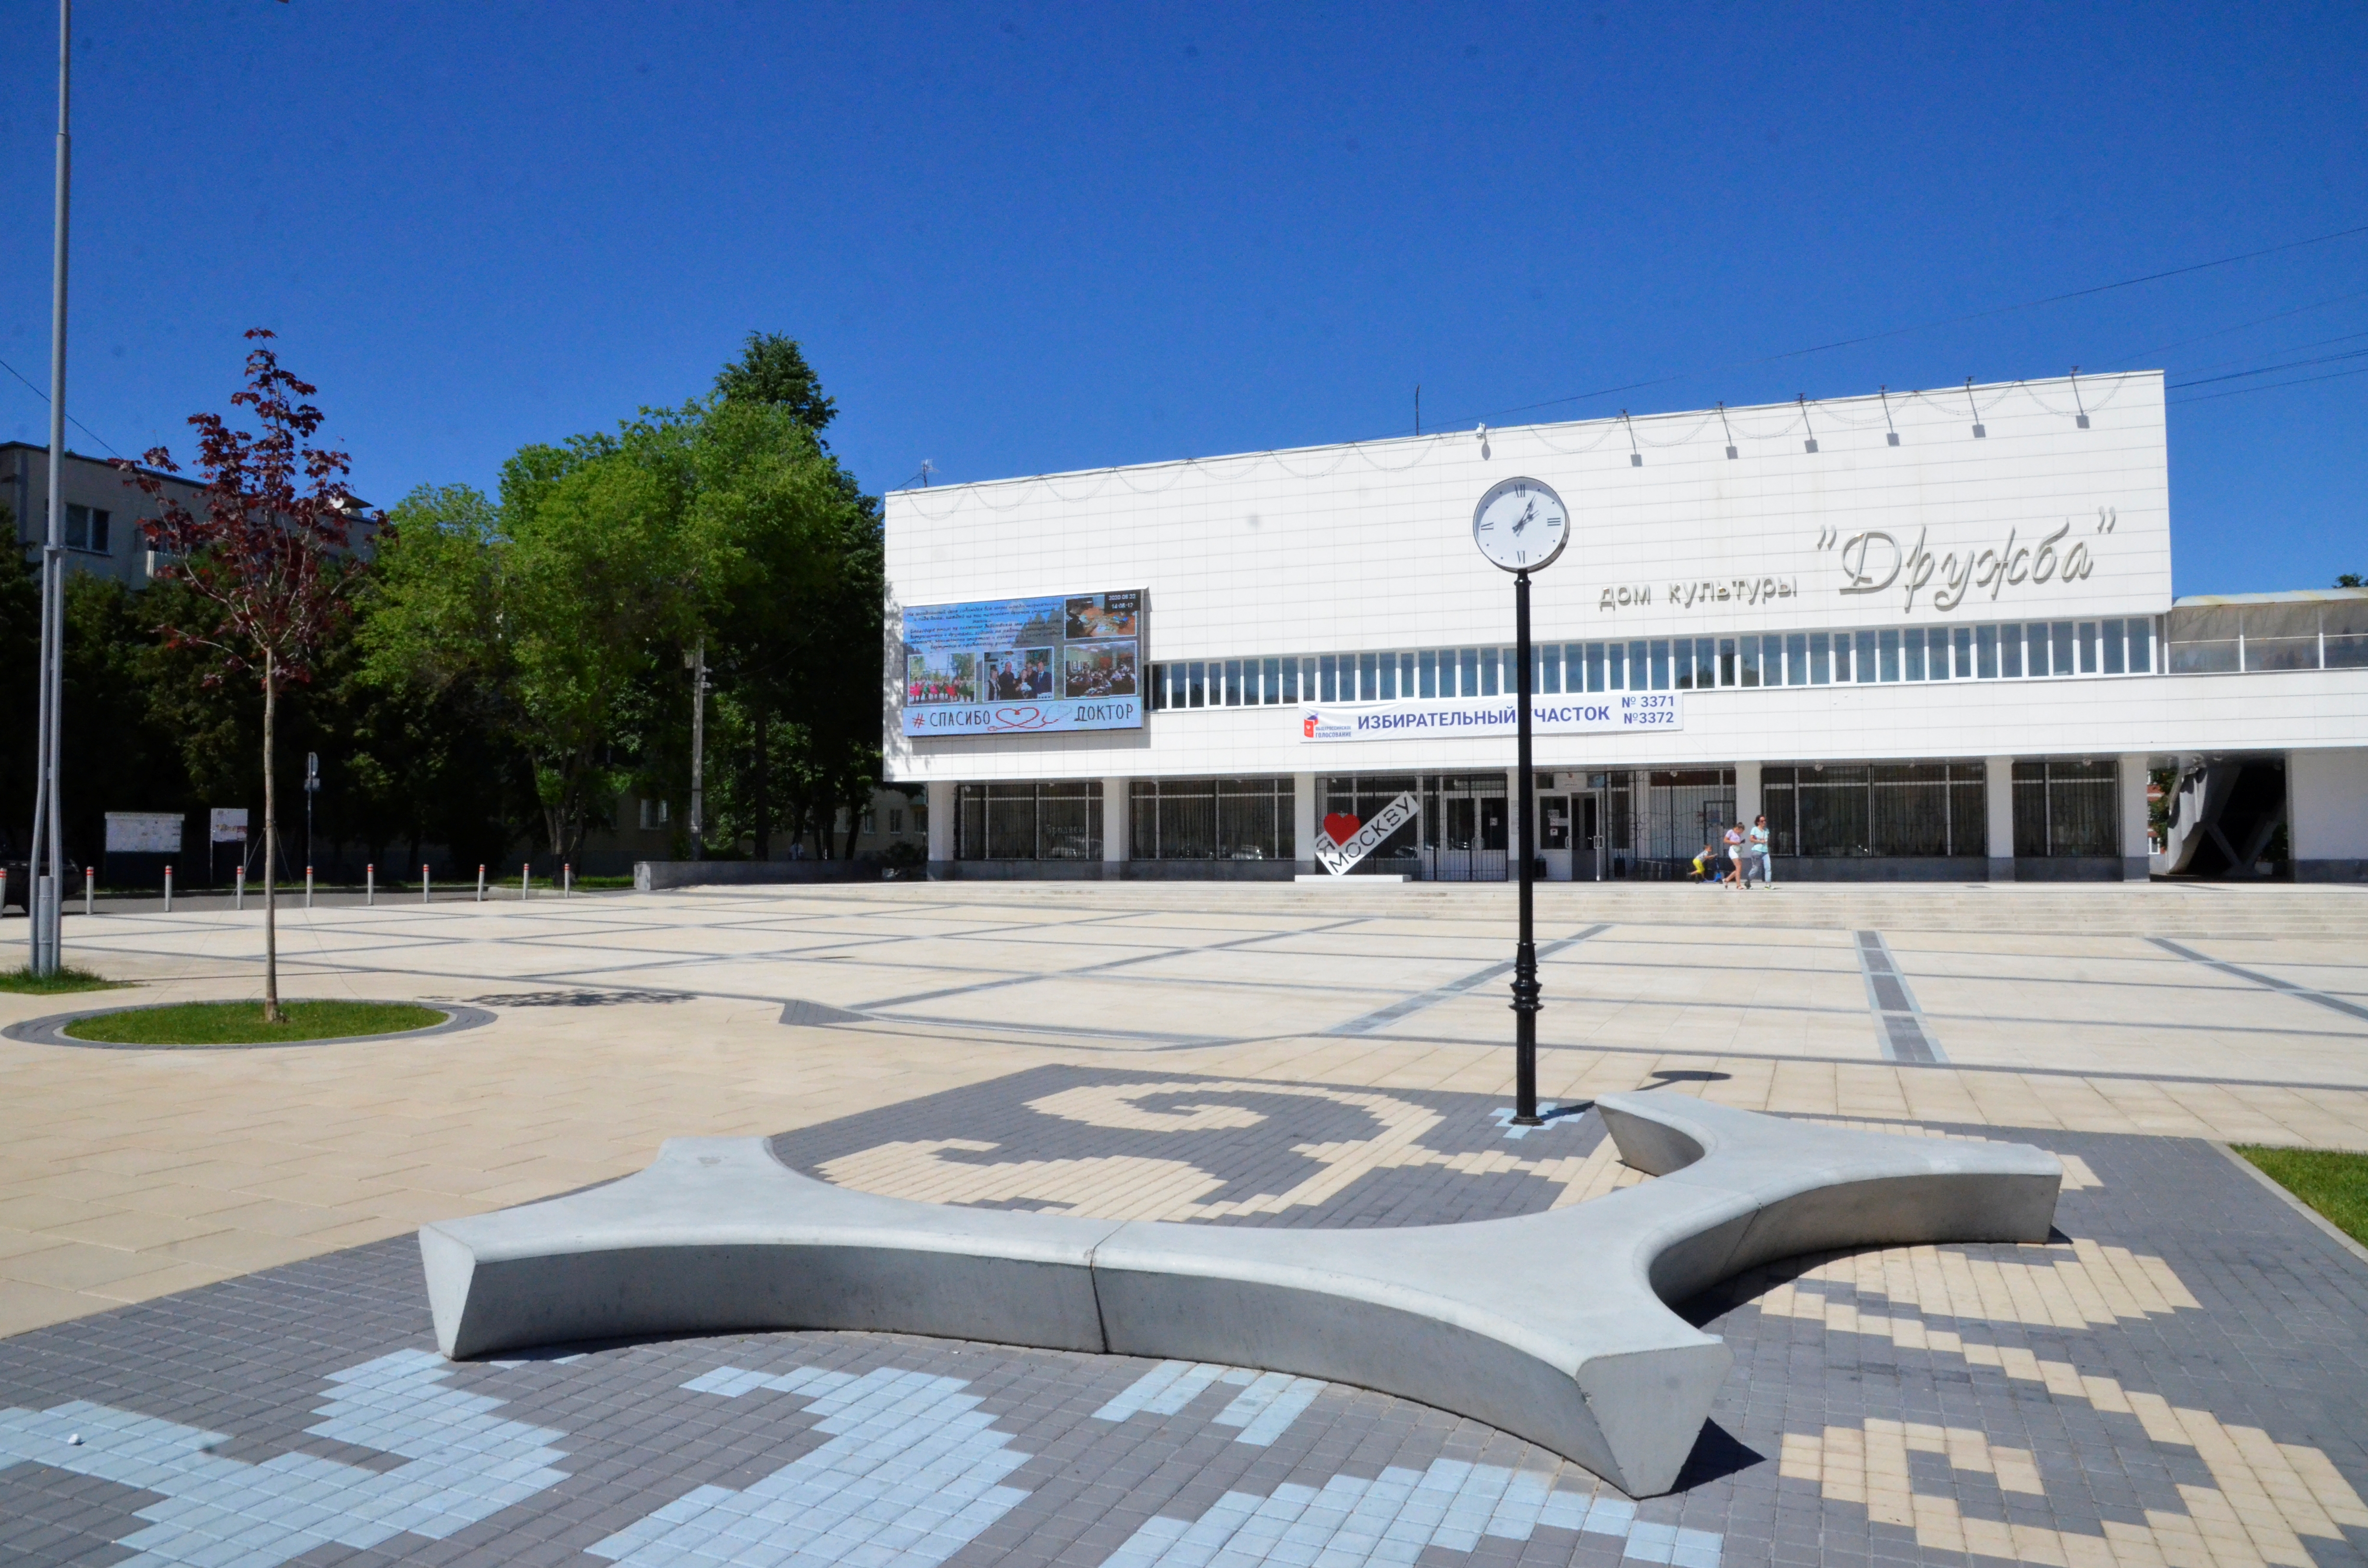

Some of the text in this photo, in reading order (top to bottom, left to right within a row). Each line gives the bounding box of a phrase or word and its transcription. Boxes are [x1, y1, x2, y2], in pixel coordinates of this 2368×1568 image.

[1599, 584, 1651, 612] дом
[1667, 576, 1797, 609] культуры
[1073, 703, 1133, 722] ДОКТОР
[1640, 695, 1674, 708] 3371
[1357, 706, 1611, 730] ИЗБИРАТЕЛЬНЫЙ ЧАСТОК
[1316, 796, 1410, 874] Я МОСКВУ
